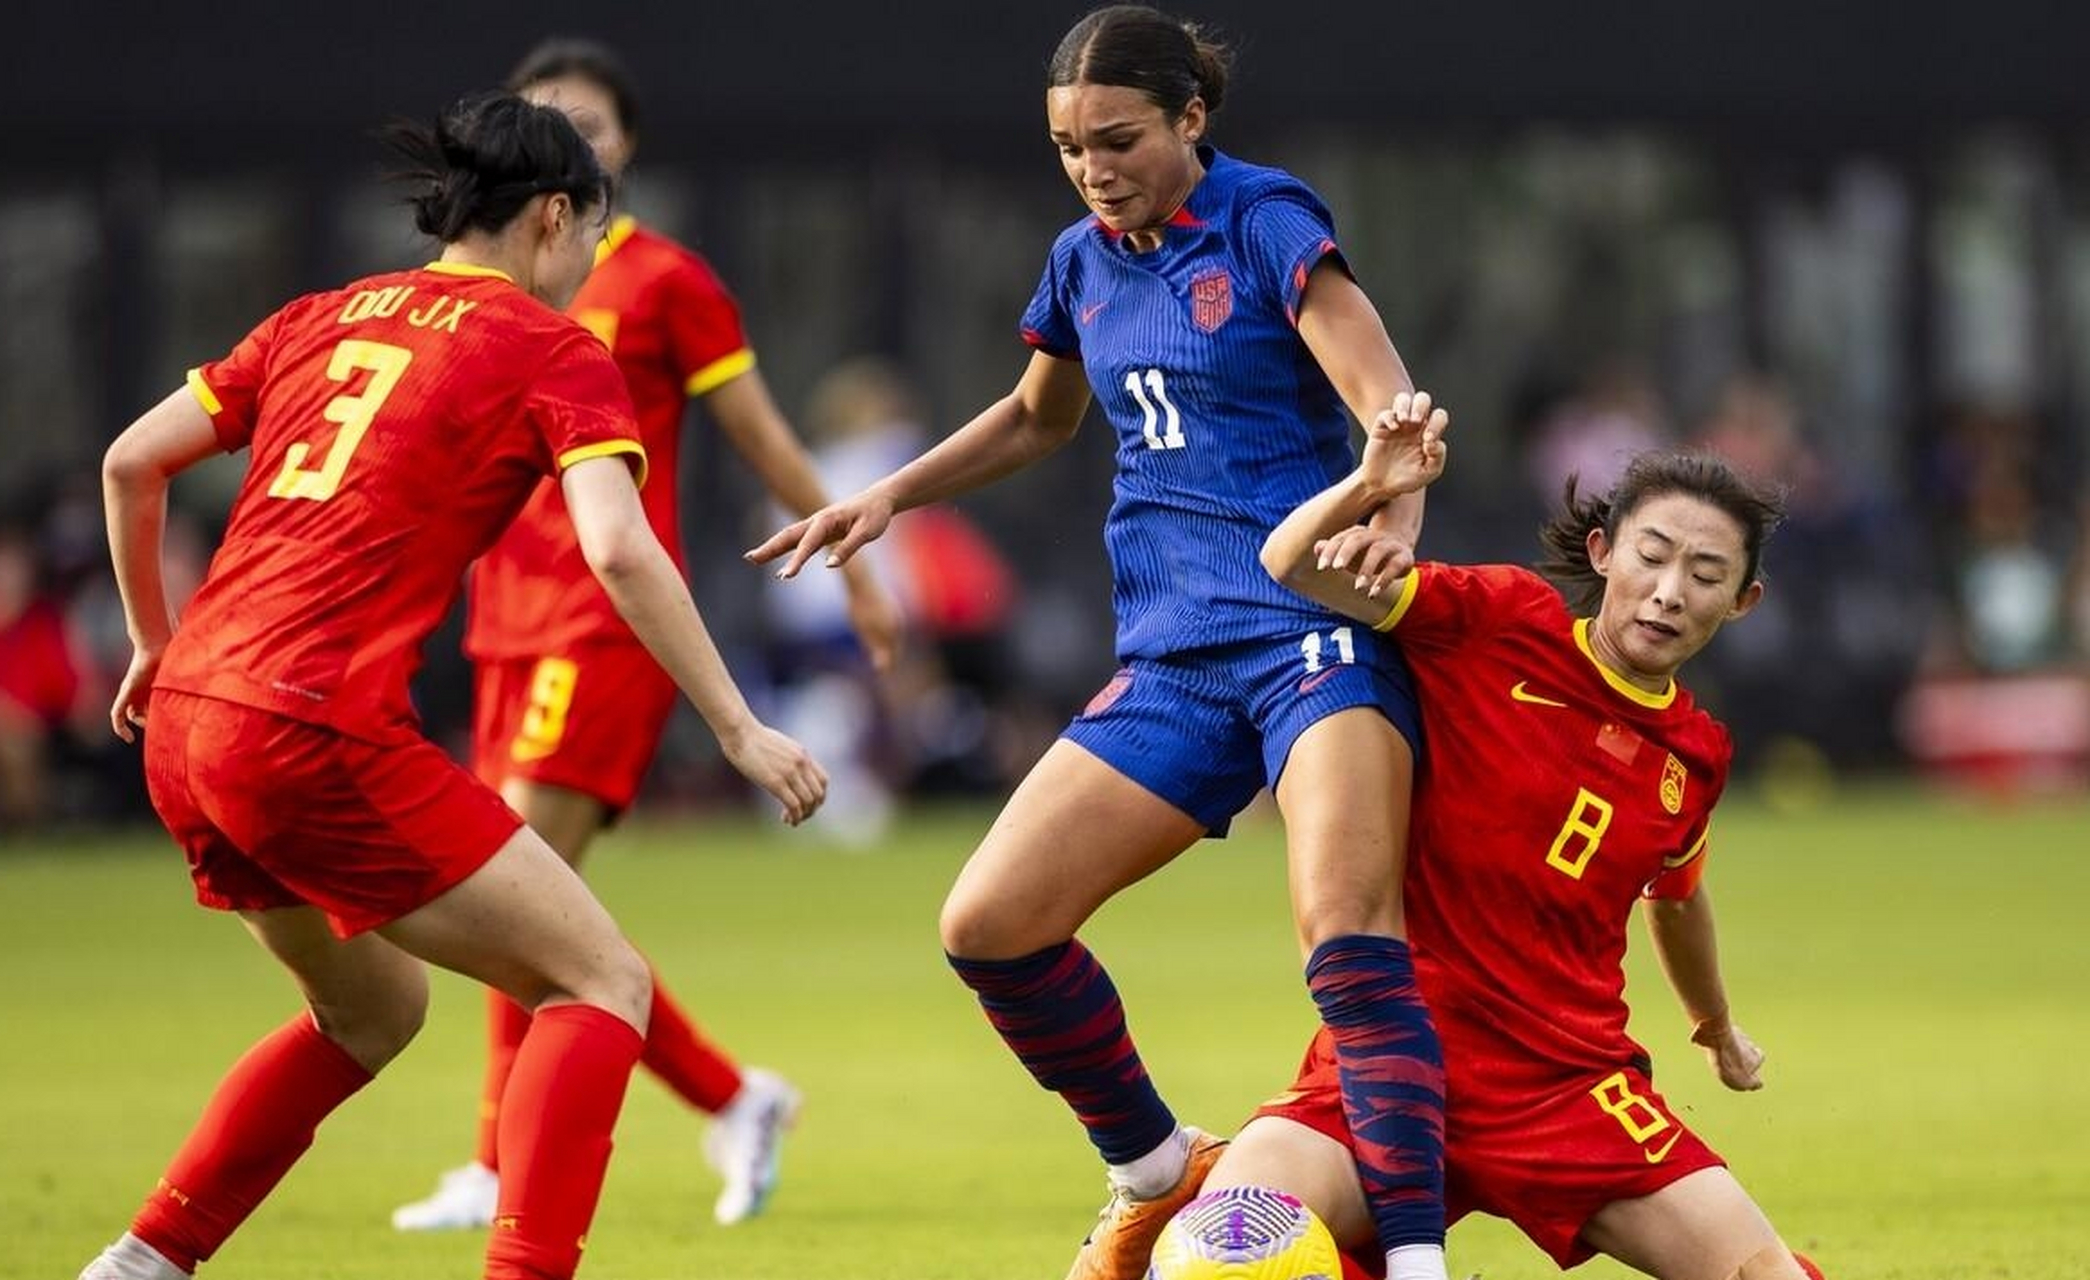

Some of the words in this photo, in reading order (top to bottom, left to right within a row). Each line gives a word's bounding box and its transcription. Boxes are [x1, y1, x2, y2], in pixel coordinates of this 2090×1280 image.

[408, 295, 478, 333] JX
[267, 339, 413, 502] 3
[1125, 368, 1186, 449] 11
[1301, 627, 1355, 672] 11
[510, 657, 579, 762] 9
[1545, 786, 1614, 879] 8
[1589, 1071, 1671, 1144] 8
